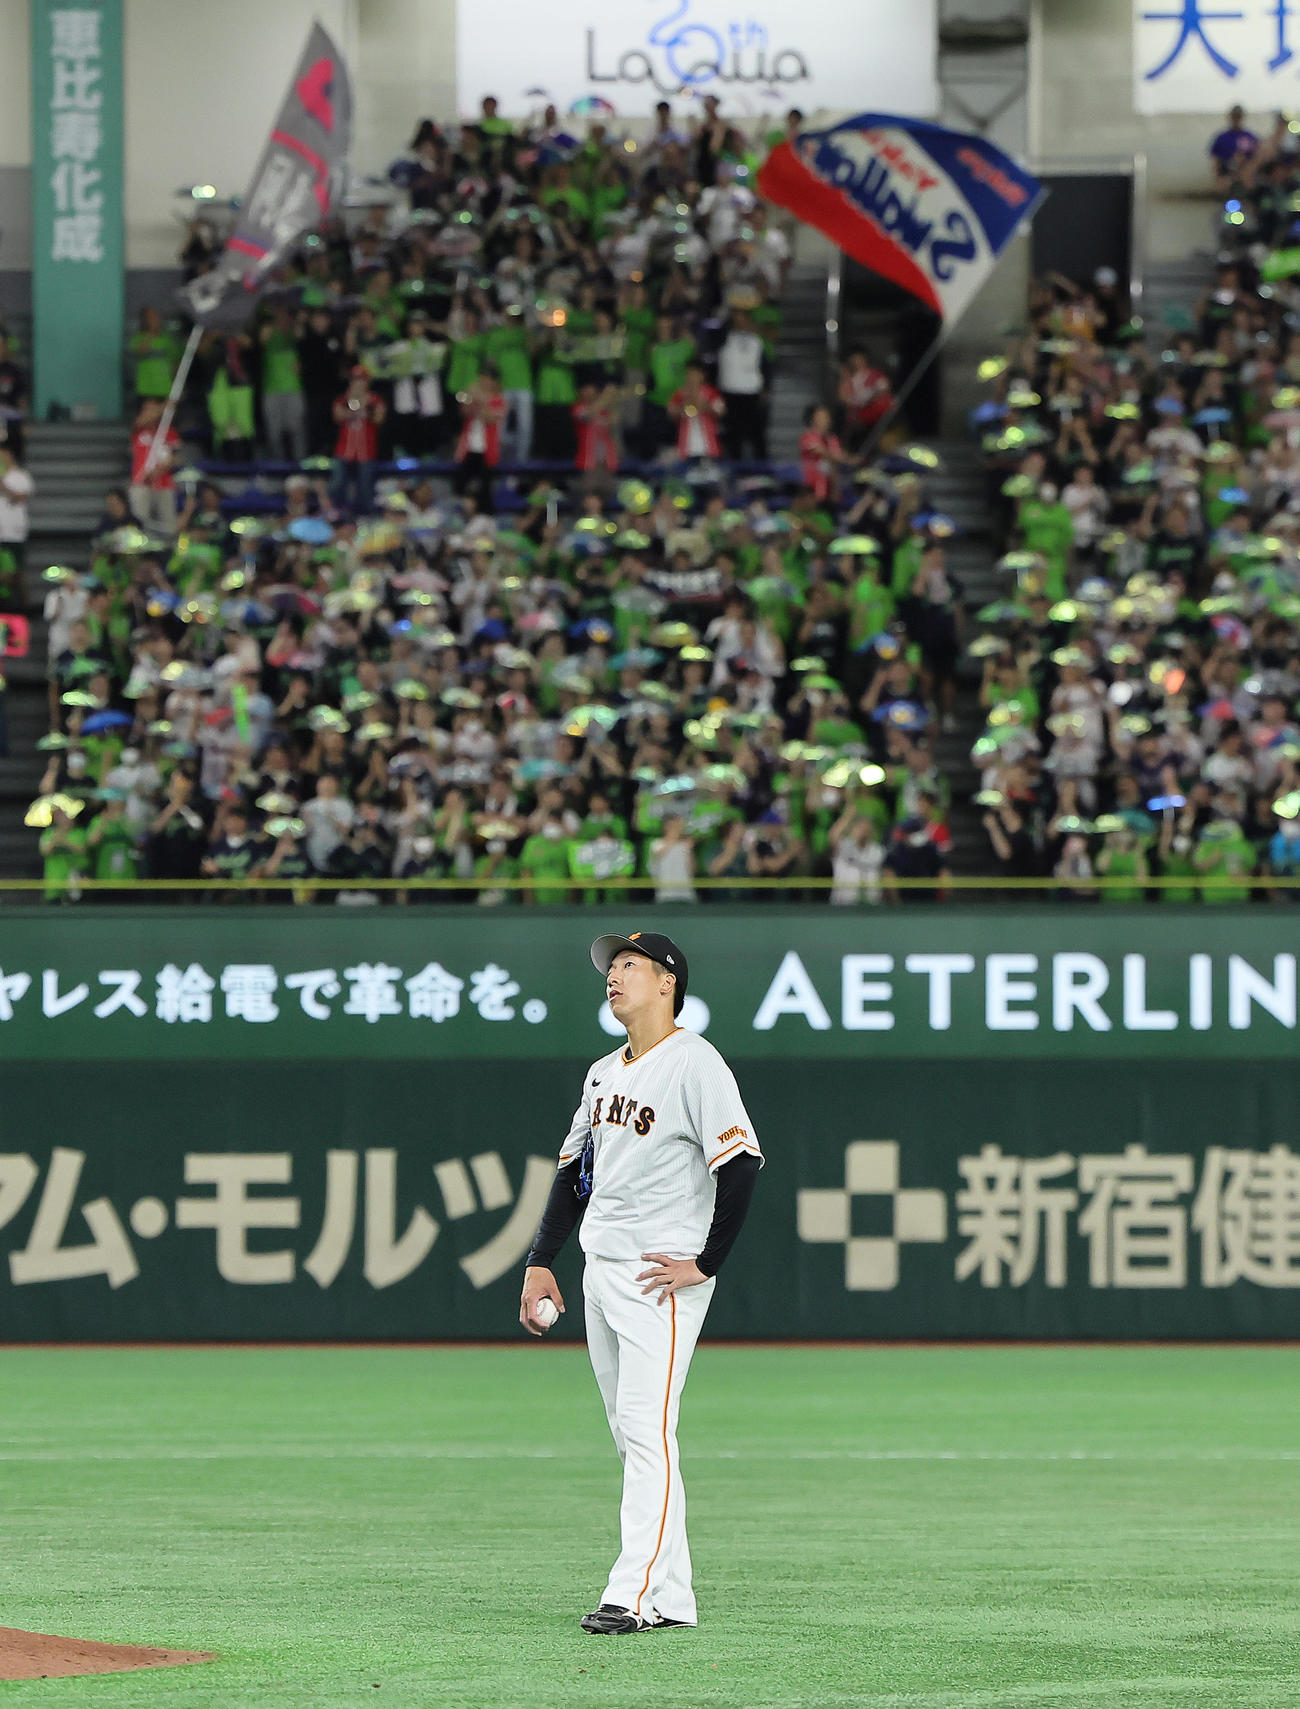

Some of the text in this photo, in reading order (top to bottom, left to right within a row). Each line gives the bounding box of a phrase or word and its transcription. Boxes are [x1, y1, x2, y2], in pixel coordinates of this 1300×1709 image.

[752, 951, 1298, 1031] AETERLIN
[955, 1143, 1300, 1289] 新宿健
